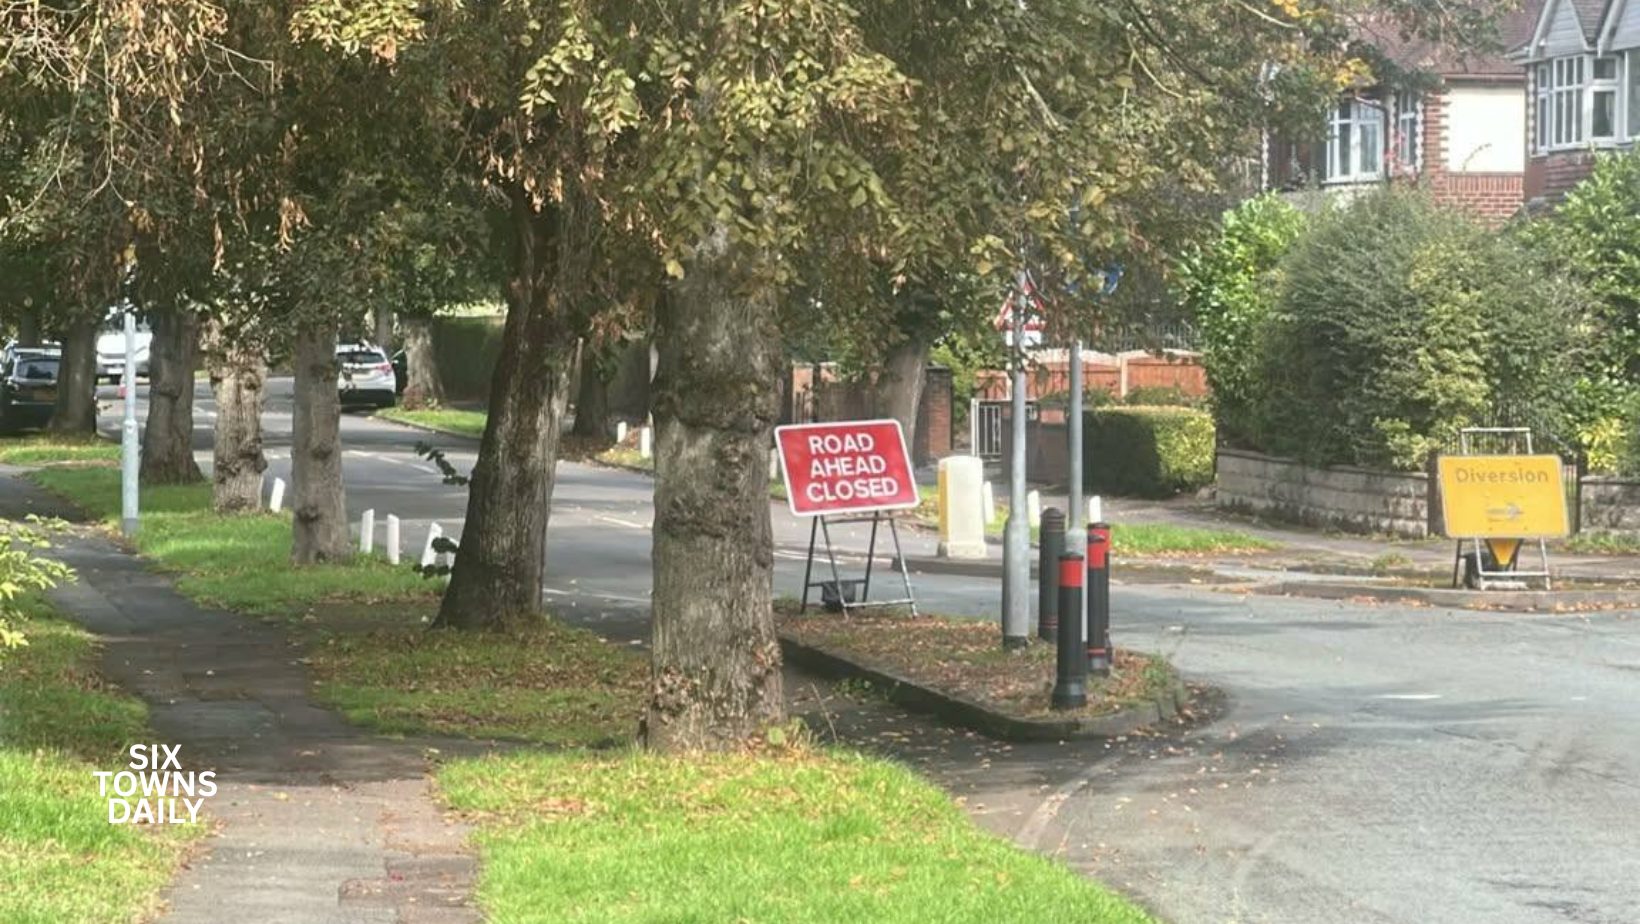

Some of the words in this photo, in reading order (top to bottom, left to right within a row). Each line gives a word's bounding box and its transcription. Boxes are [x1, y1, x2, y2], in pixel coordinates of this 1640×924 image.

[808, 433, 874, 454] ROAD
[810, 455, 886, 478] AHEAD
[1455, 467, 1549, 483] Diversion
[806, 477, 898, 502] CLOSED
